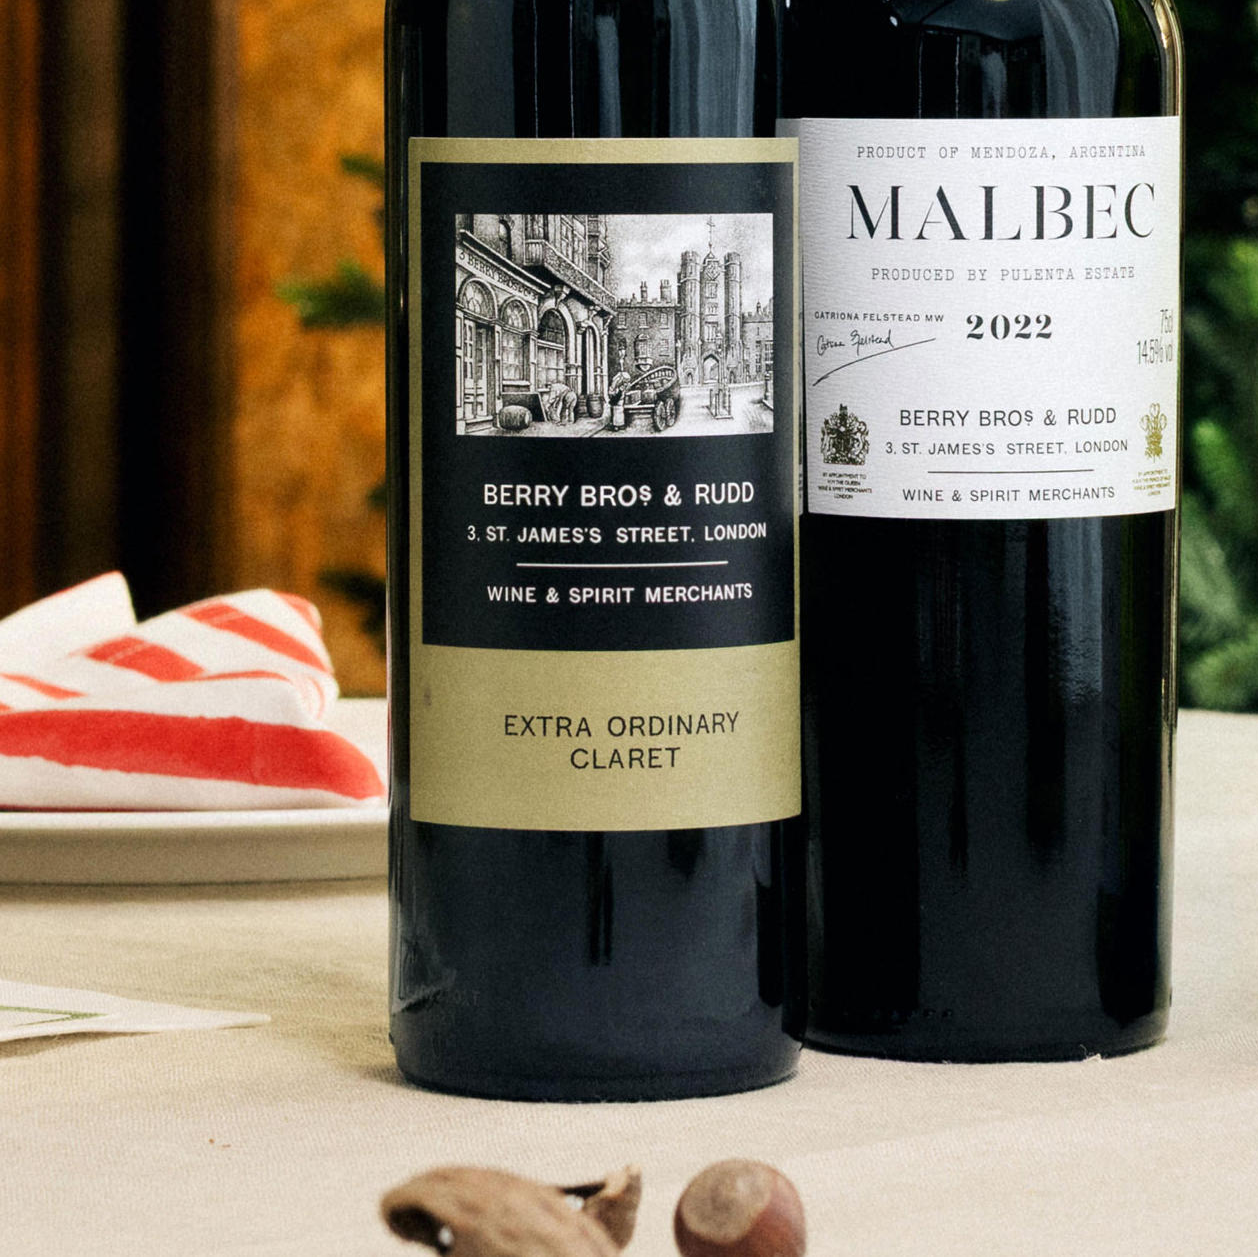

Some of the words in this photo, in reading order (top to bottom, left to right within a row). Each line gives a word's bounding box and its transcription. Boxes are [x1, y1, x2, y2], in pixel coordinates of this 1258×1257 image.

[856, 145, 927, 159] PRODUCT
[938, 146, 959, 159] OF
[970, 146, 1056, 161] MENDOZA,
[1068, 144, 1146, 159] ARGENTINA
[846, 182, 1155, 241] MALBEC
[871, 267, 955, 282] PRODUCED
[967, 268, 988, 282] BY
[1000, 267, 1075, 282] PULENTA
[1084, 265, 1135, 280] ESTATE
[814, 310, 860, 321] CATRIONA
[862, 312, 921, 323] FELSTEAD
[924, 314, 945, 323] MW
[966, 313, 1052, 341] 2022
[899, 409, 970, 427] BERRY
[1043, 409, 1057, 427] &
[1067, 407, 1117, 426] RUDD
[928, 442, 995, 456] JAMES'S
[1075, 440, 1129, 453] LONDON
[483, 483, 569, 507] BERRY
[663, 483, 682, 507] &
[695, 481, 755, 505] RUDD
[902, 488, 944, 502] WINE
[951, 489, 962, 502] &
[969, 489, 1021, 502] SPIRIT
[1028, 486, 1115, 502] MERCHANTS
[486, 525, 510, 542] ST.
[517, 526, 602, 544] JAMES'S
[704, 522, 767, 542] LONDON
[486, 585, 537, 603] WINE
[545, 586, 560, 604] &
[569, 587, 635, 604] SPIRIT
[645, 582, 753, 603] MERCHANTS
[504, 714, 592, 738] EXTRA
[607, 710, 739, 738] ORDINARY
[569, 746, 681, 770] CLARET
